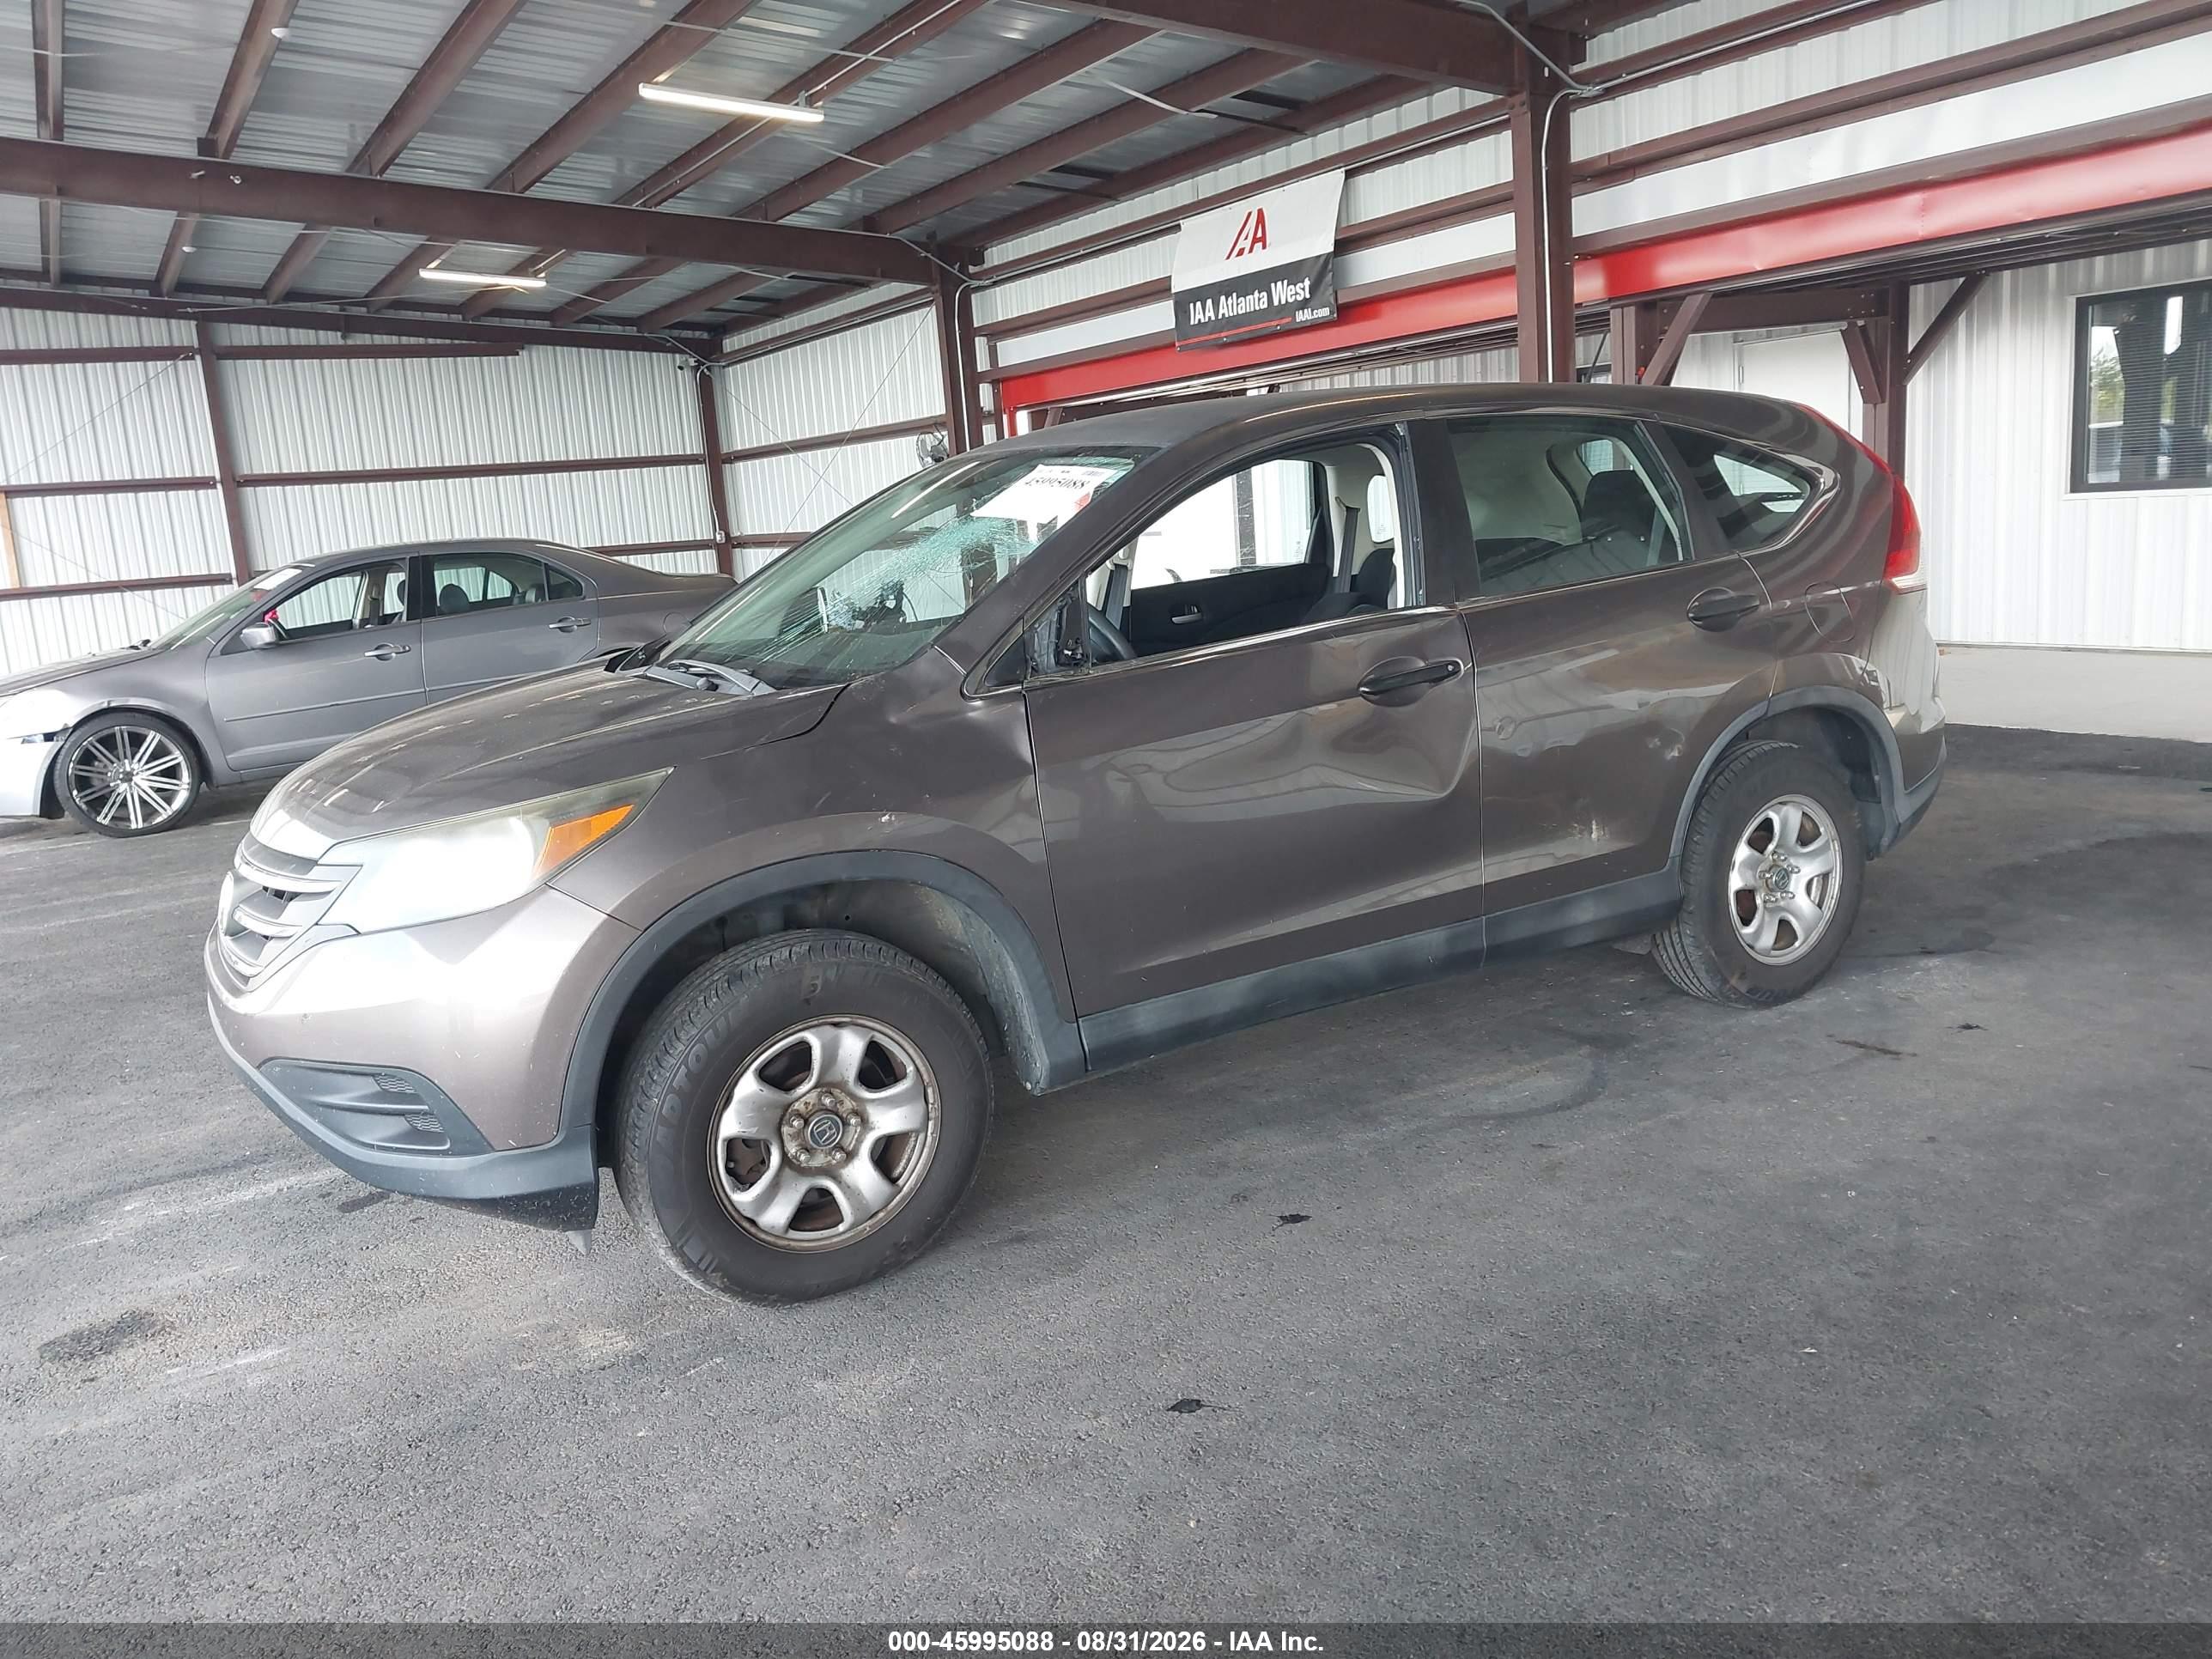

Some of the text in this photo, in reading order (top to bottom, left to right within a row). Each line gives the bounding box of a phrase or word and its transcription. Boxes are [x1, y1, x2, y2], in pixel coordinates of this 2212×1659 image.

[1189, 276, 1311, 325] IAA Atlanta West
[1295, 307, 1330, 323] IAAI.com
